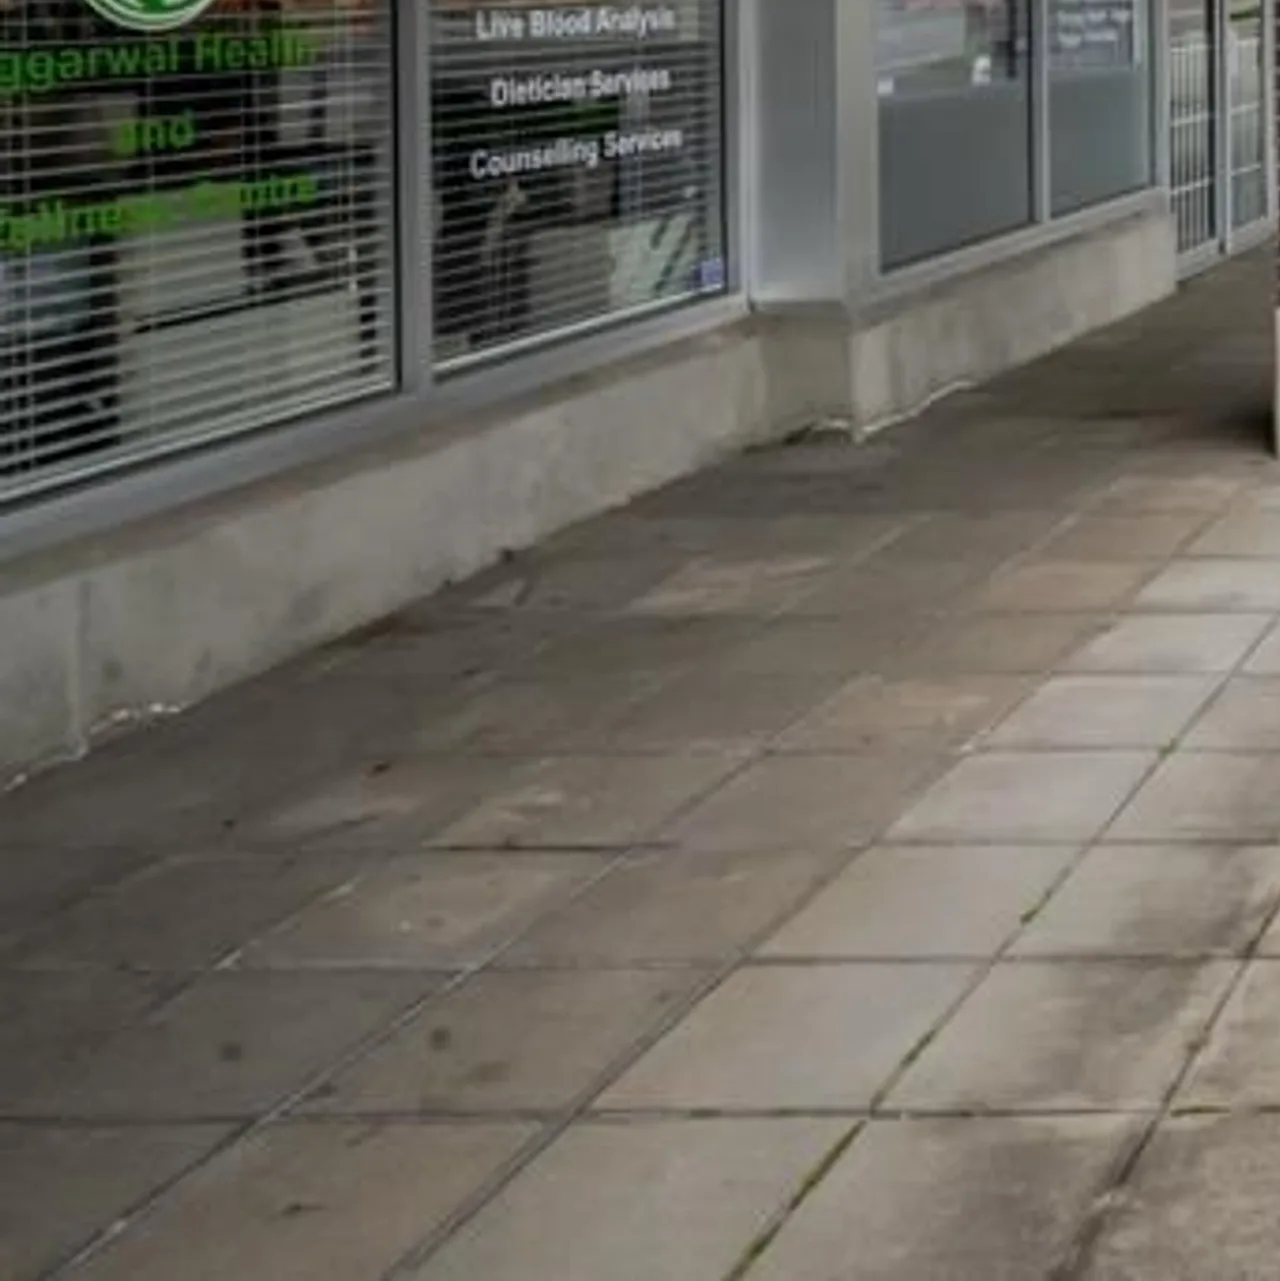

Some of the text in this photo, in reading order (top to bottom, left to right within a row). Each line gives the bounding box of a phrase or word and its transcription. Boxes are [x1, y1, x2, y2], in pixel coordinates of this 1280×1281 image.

[476, 6, 675, 40] Live Blood Analysis
[590, 69, 671, 98] Services
[114, 110, 194, 154] nd
[469, 129, 684, 179] Counselling Services
